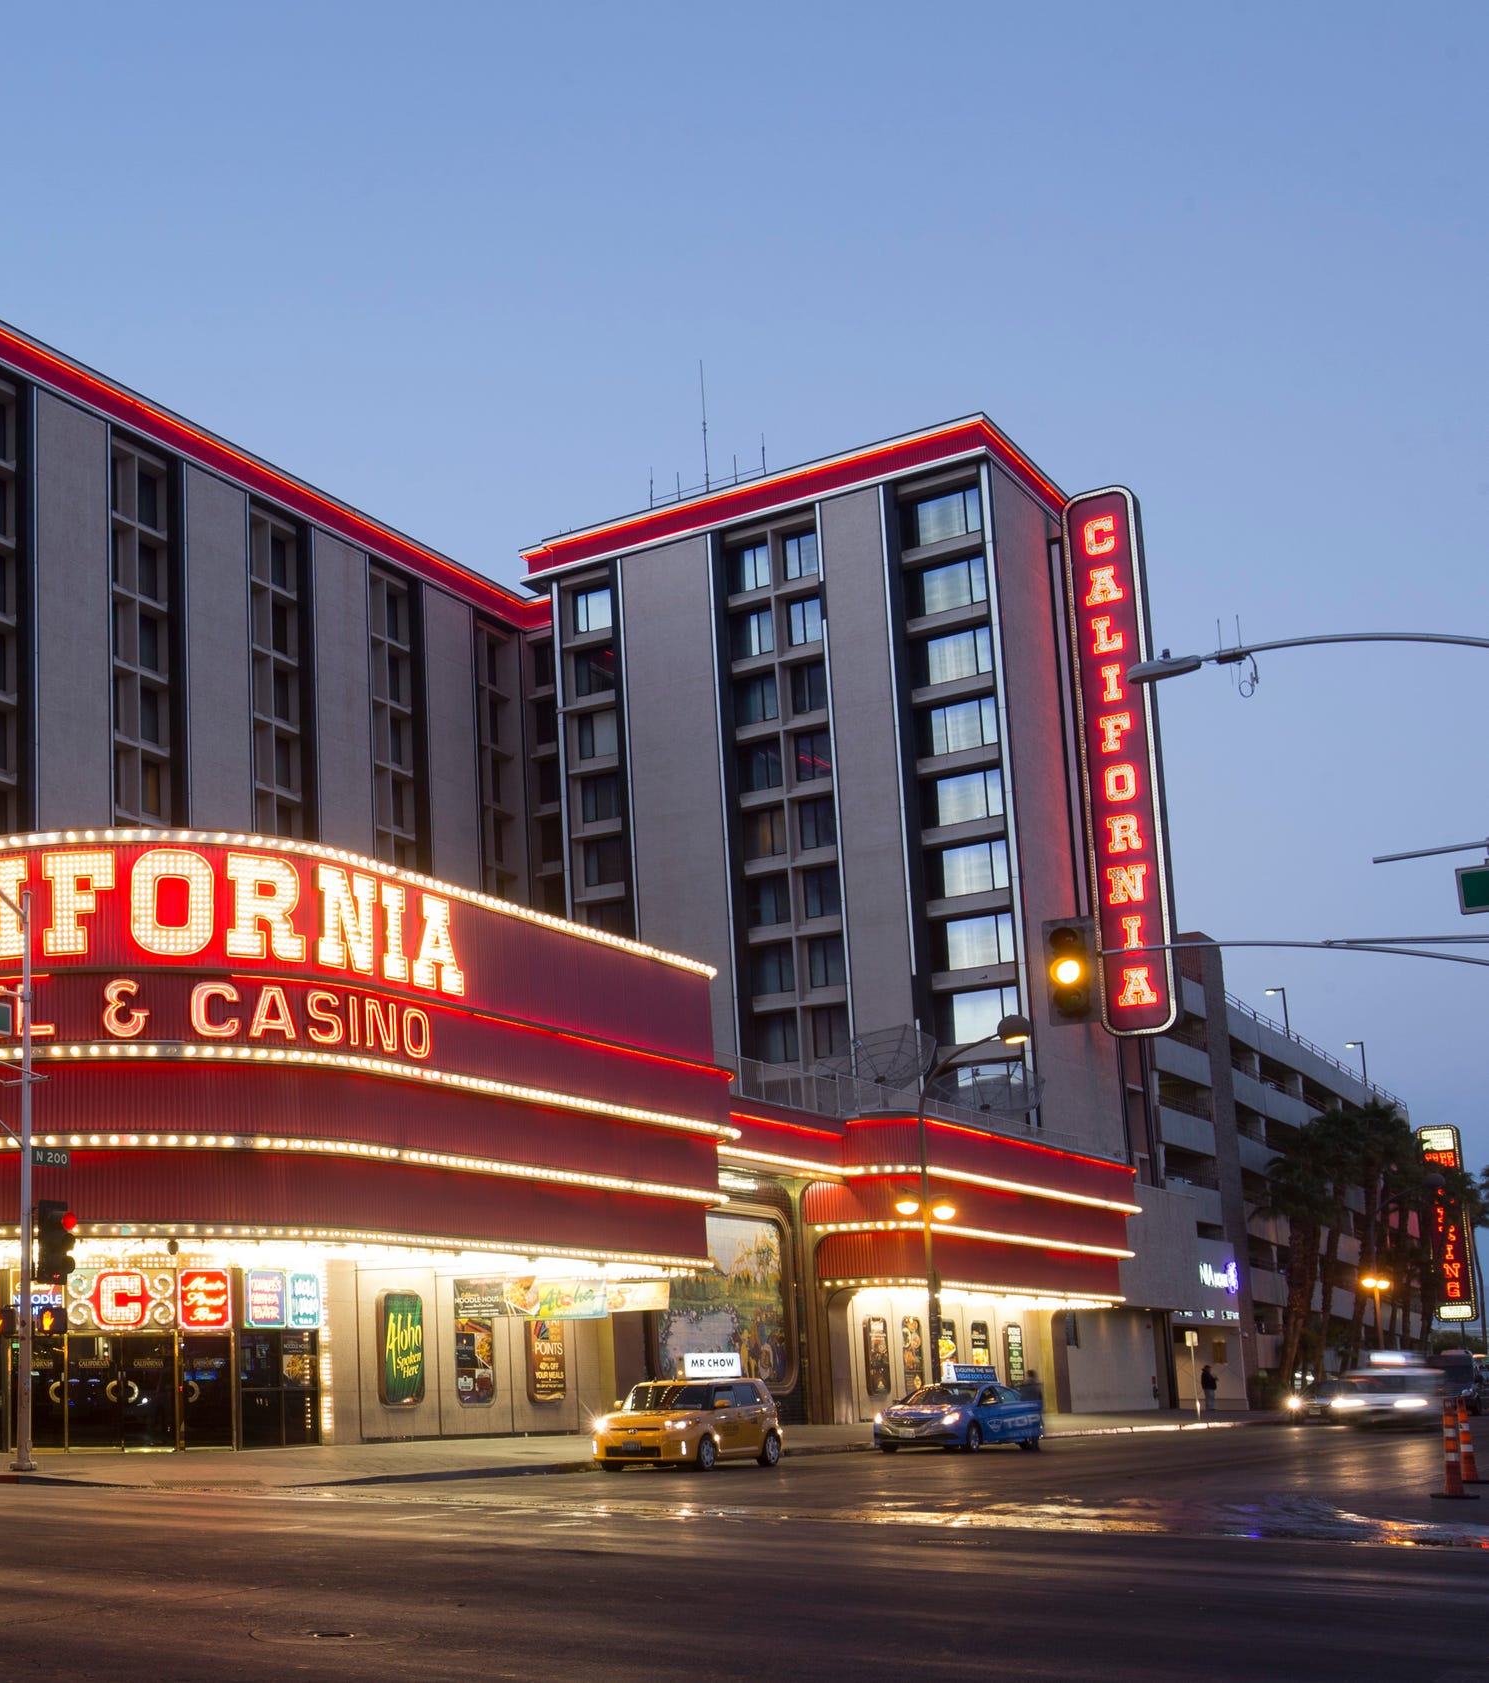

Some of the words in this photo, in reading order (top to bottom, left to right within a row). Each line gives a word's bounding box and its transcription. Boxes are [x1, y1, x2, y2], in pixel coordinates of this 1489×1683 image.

[1084, 514, 1158, 1007] CALIFORNIA
[103, 979, 150, 1039] &
[190, 981, 432, 1060] CASINO
[36, 1151, 44, 1162] N
[47, 1152, 68, 1165] 200
[182, 1277, 227, 1291] Main
[13, 1294, 62, 1305] NODLE
[184, 1292, 227, 1306] Street
[454, 1296, 481, 1304] NOODLE
[189, 1307, 223, 1321] Bar
[253, 1305, 280, 1320] BAR
[534, 1342, 563, 1355] POINTS
[78, 1360, 110, 1368] CALIFORNIA
[133, 1360, 164, 1368] CALIFORNIA
[397, 1352, 422, 1372] Spoken
[551, 1362, 559, 1370] OFF
[691, 1358, 706, 1368] MR
[707, 1358, 735, 1368] CHOW
[403, 1364, 419, 1379] Here
